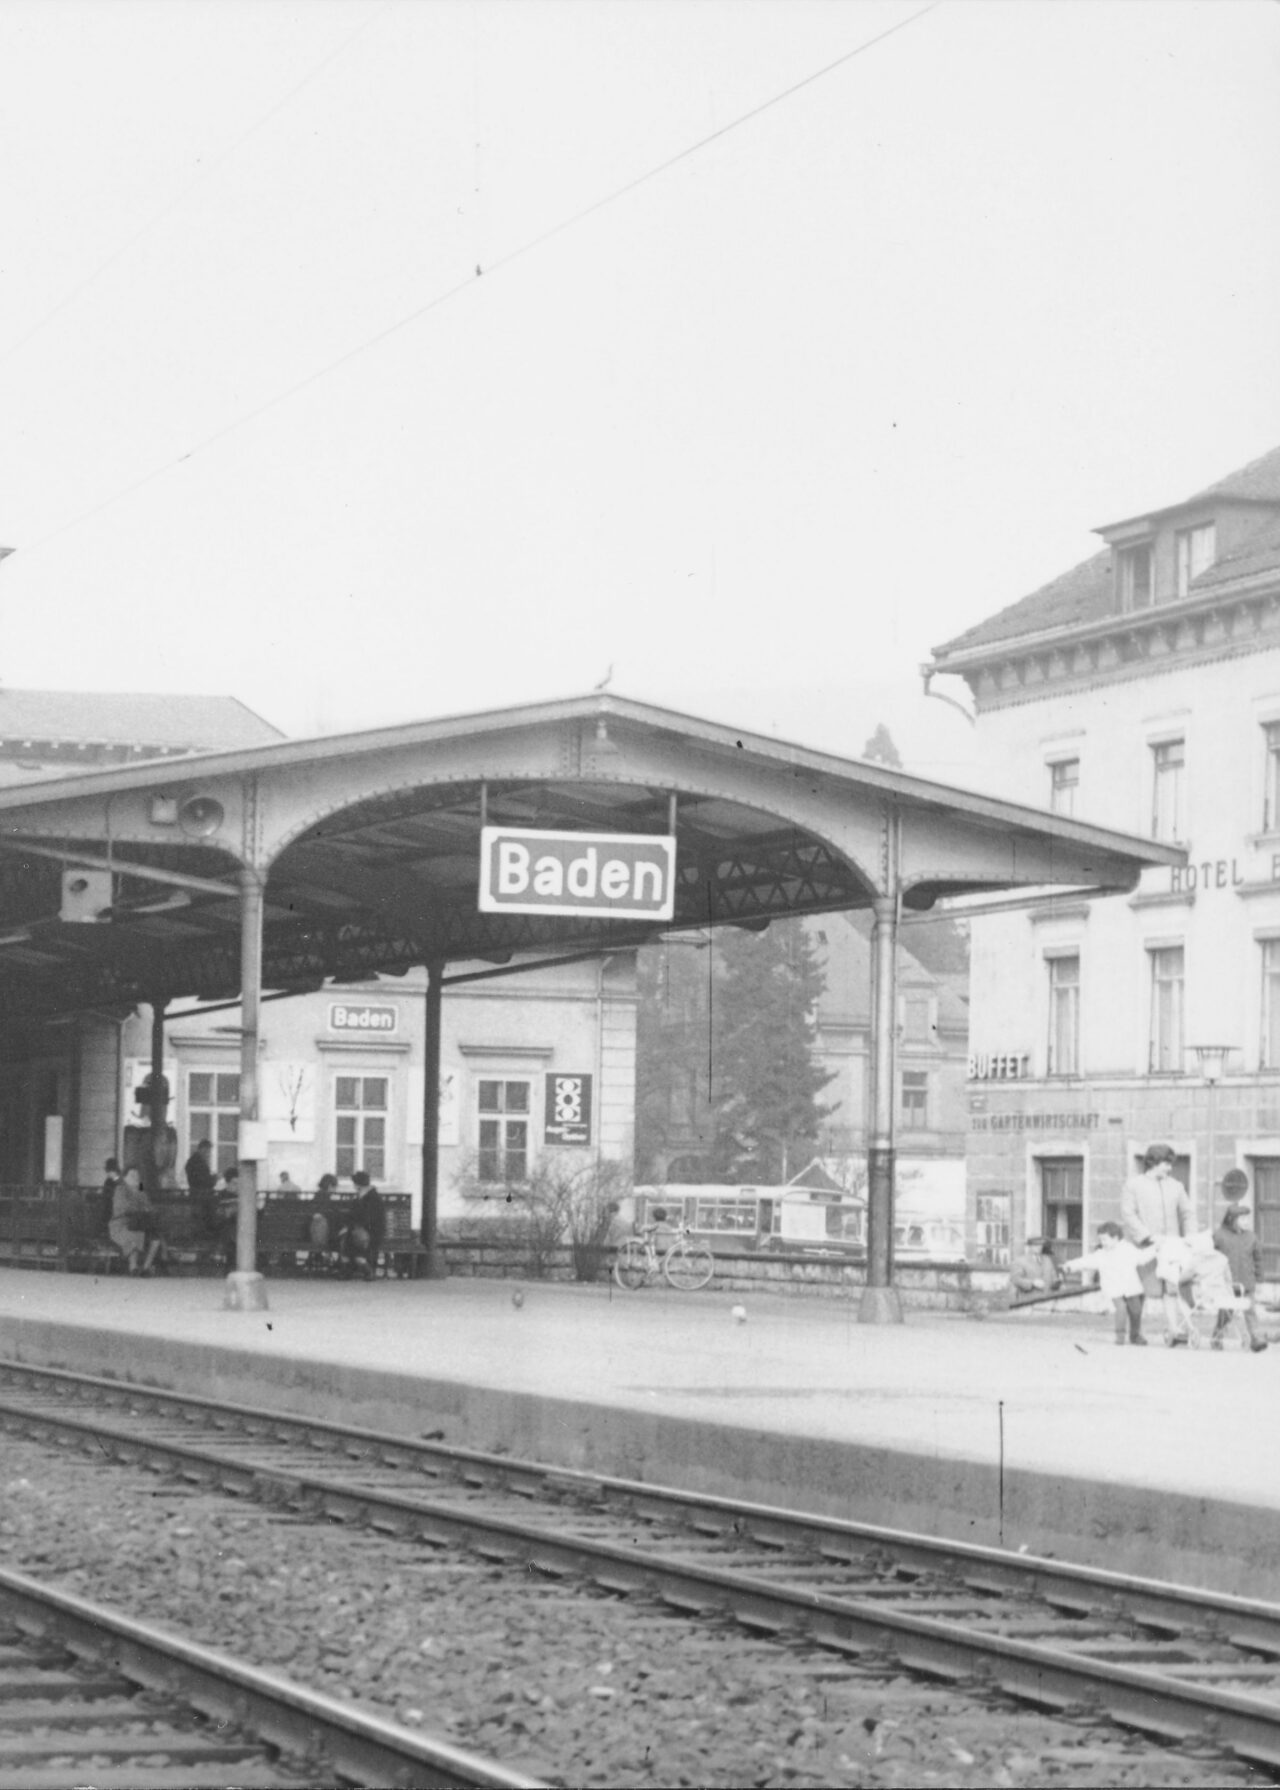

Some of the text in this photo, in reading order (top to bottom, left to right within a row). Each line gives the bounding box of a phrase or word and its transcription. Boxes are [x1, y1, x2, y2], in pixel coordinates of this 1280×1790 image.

[498, 842, 663, 901] Baden
[1170, 859, 1244, 894] HOTEL
[334, 1007, 393, 1029] Baden
[969, 1054, 1030, 1080] BUFFET
[990, 1113, 1100, 1130] GARTENWIRTSCHAFT
